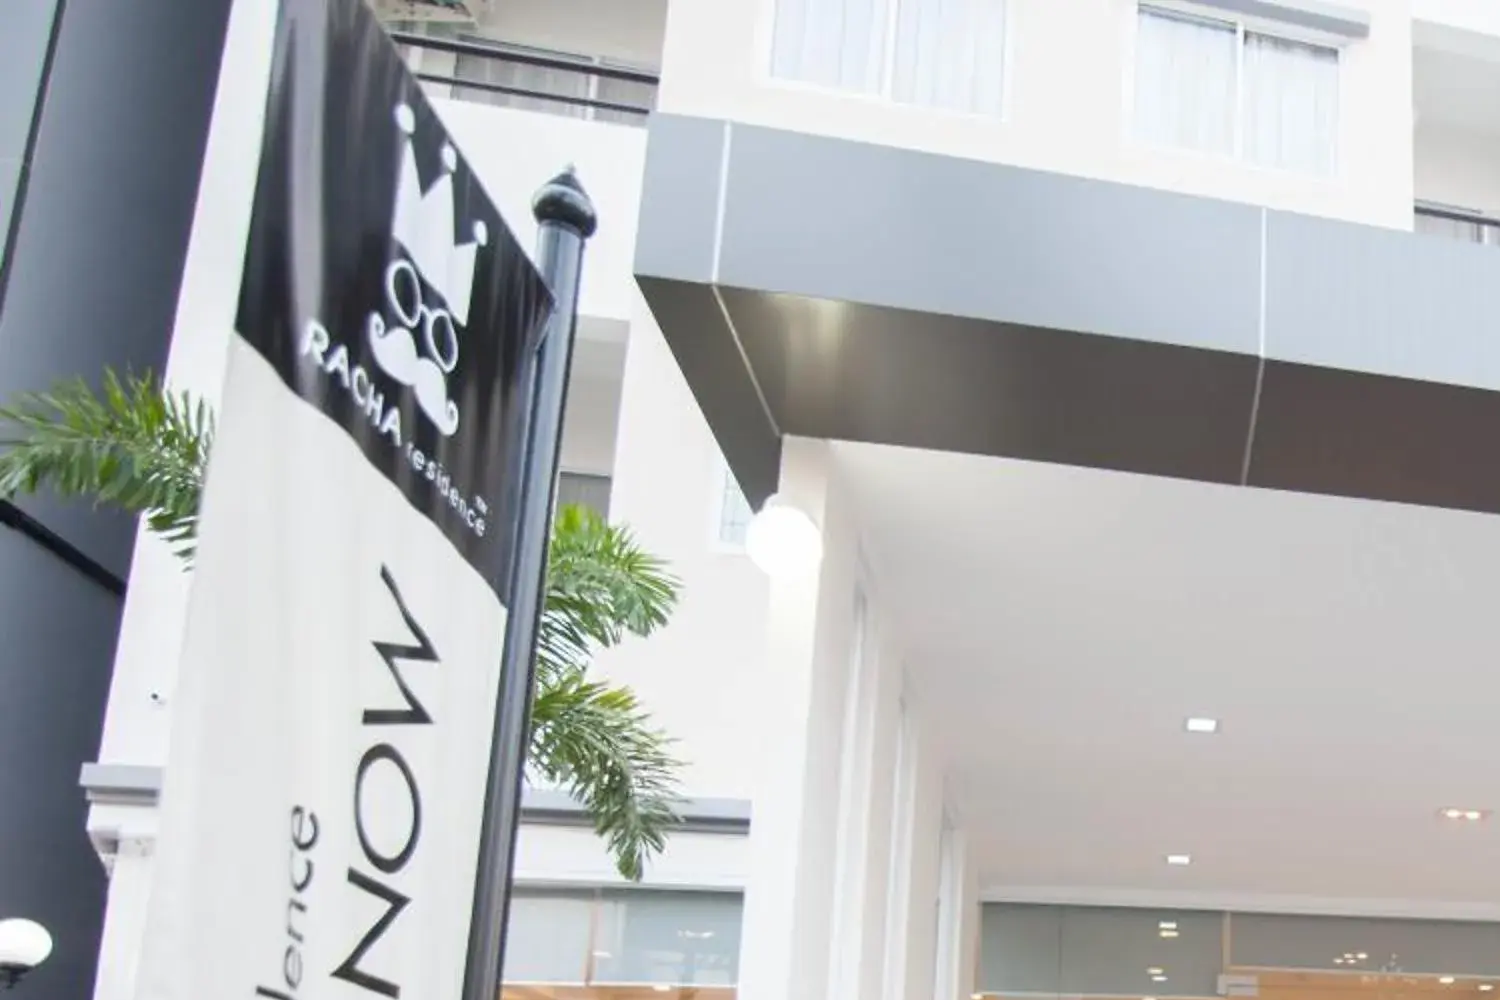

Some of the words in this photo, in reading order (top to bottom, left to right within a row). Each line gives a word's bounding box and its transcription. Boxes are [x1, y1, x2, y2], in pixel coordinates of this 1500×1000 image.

[301, 319, 402, 447] RACHA
[405, 442, 485, 537] residence
[329, 562, 441, 1000] NOW
